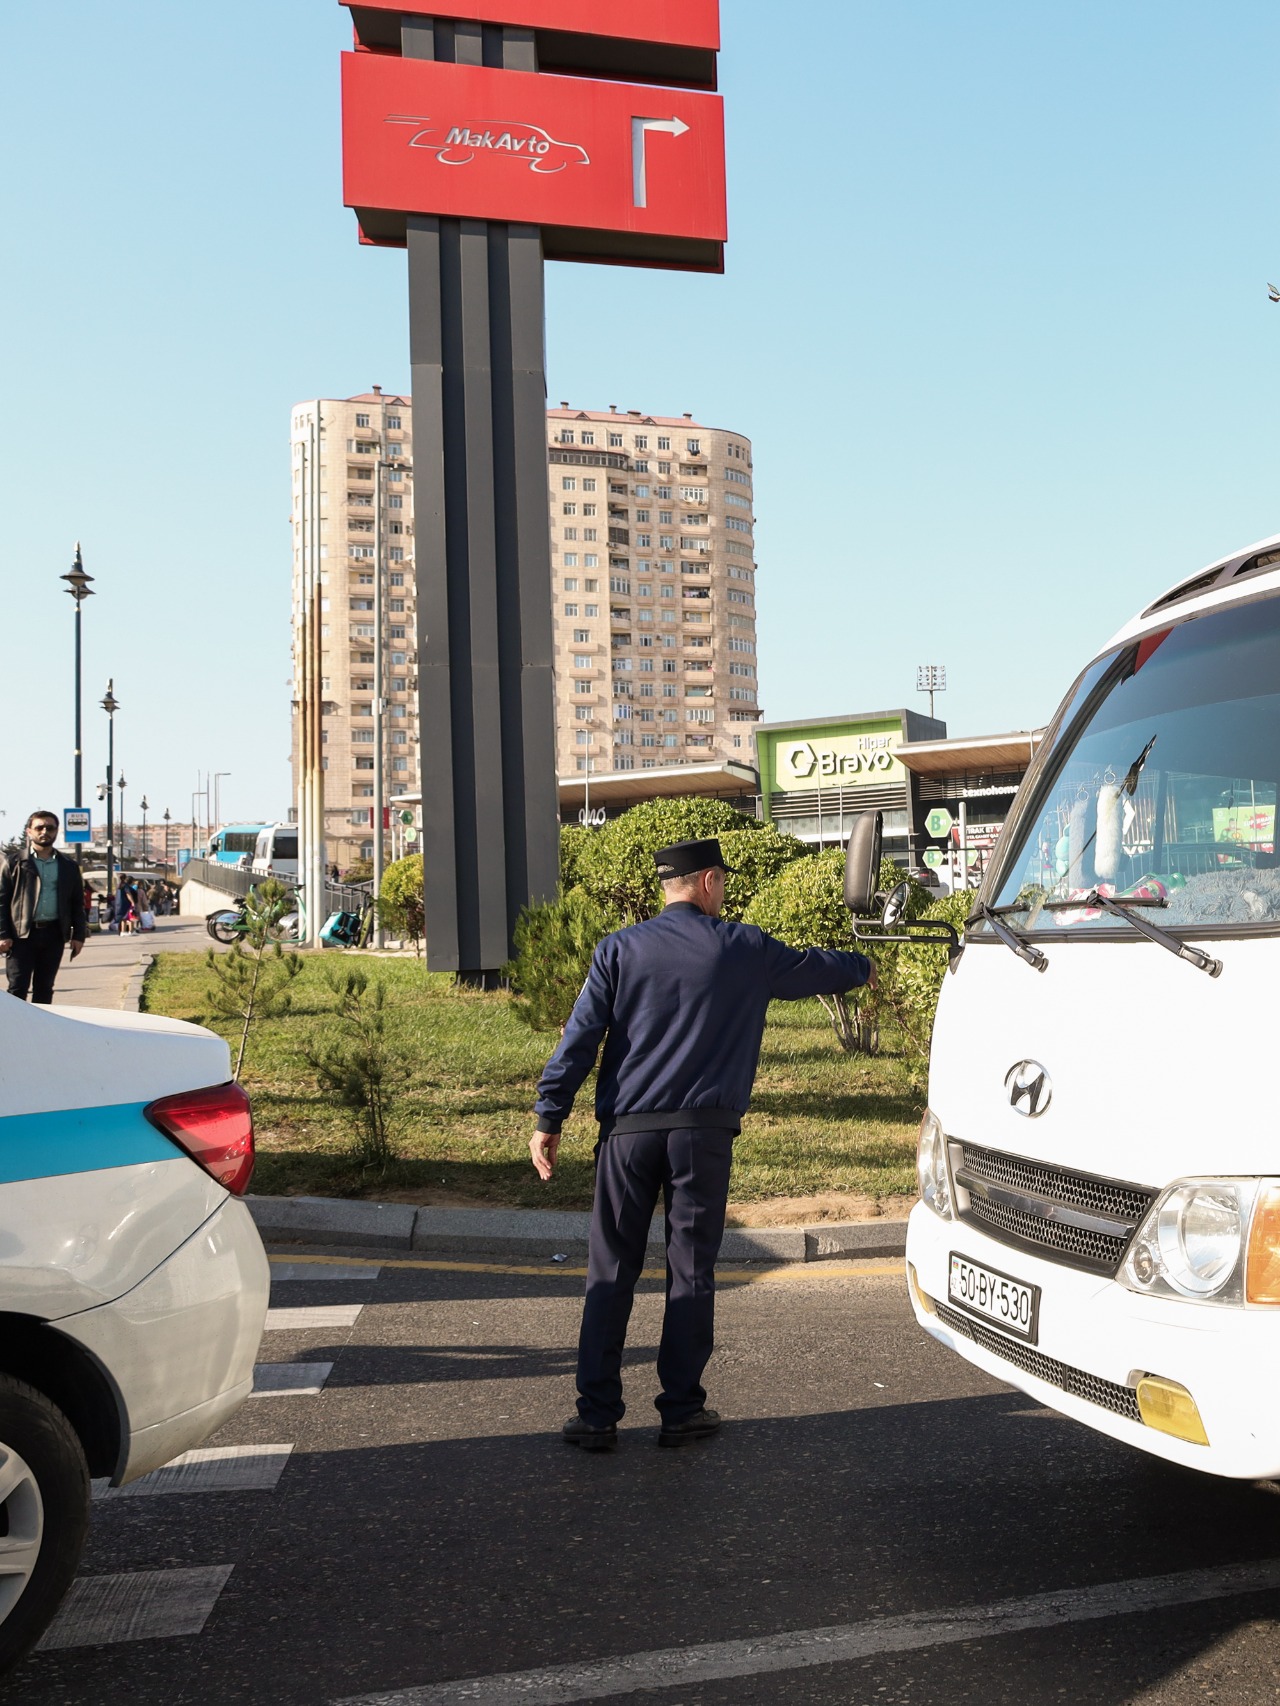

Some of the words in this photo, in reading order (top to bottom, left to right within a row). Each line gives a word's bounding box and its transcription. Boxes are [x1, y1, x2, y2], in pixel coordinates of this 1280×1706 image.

[444, 127, 550, 154] MakAvto
[858, 737, 892, 752] Hiper
[819, 750, 894, 776] Bravo
